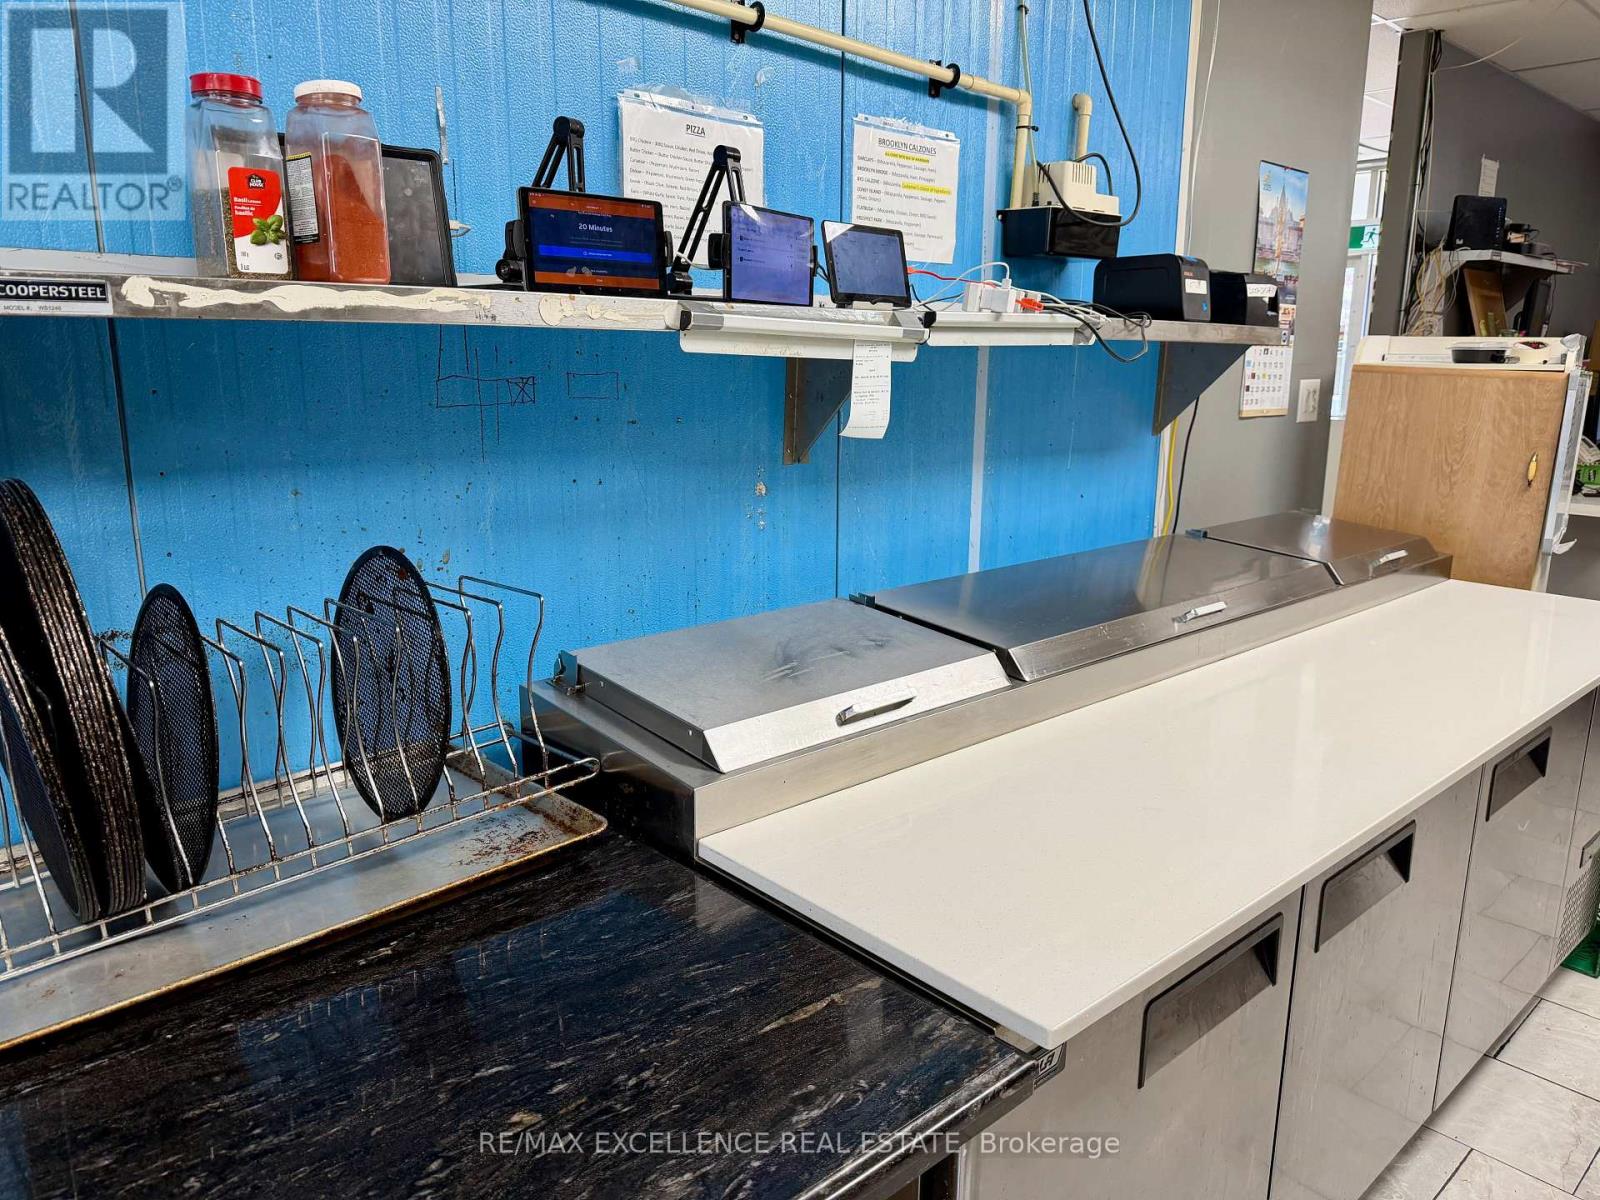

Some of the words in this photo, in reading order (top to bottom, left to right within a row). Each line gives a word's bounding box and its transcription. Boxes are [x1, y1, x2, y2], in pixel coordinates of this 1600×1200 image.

[686, 124, 706, 135] PIZZA
[878, 137, 908, 150] BROOKLYN
[909, 143, 937, 155] CALZONES
[578, 222, 588, 230] 20
[588, 223, 613, 233] Minutes
[0, 284, 105, 298] COOPERSTEEL
